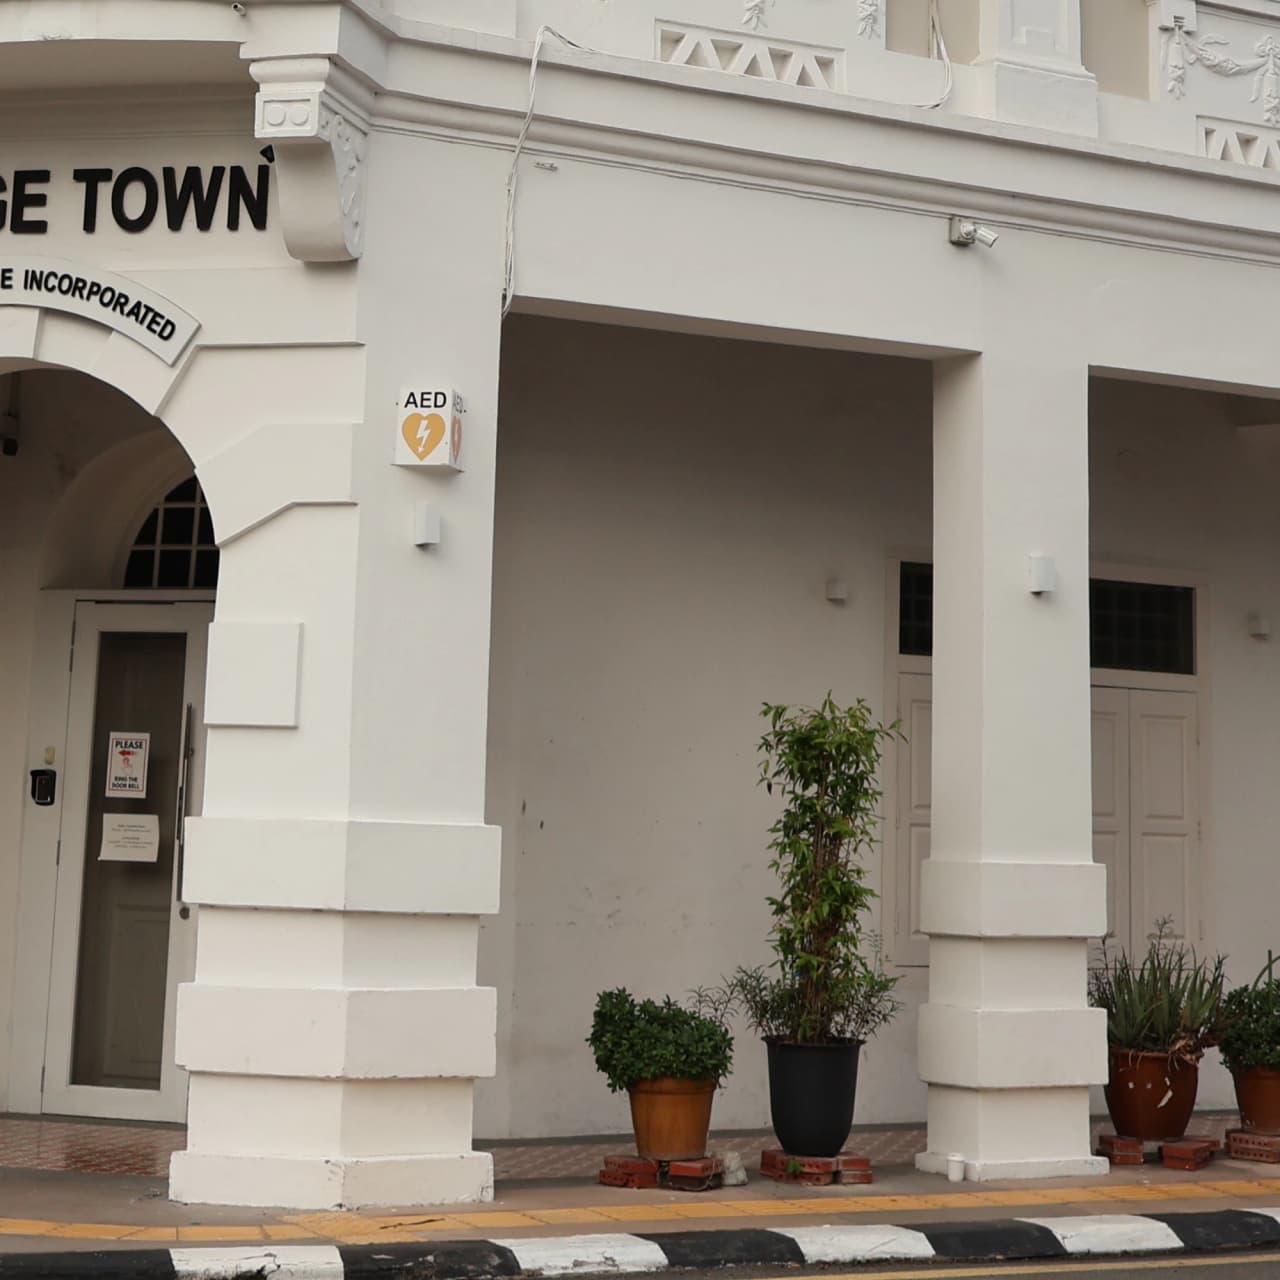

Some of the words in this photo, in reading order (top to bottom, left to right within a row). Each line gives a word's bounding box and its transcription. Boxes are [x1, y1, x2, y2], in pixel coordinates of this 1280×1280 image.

[73, 164, 270, 233] TOWN
[23, 269, 176, 341] INCORPORATED
[405, 391, 447, 409] AED
[115, 740, 143, 749] PLEASE
